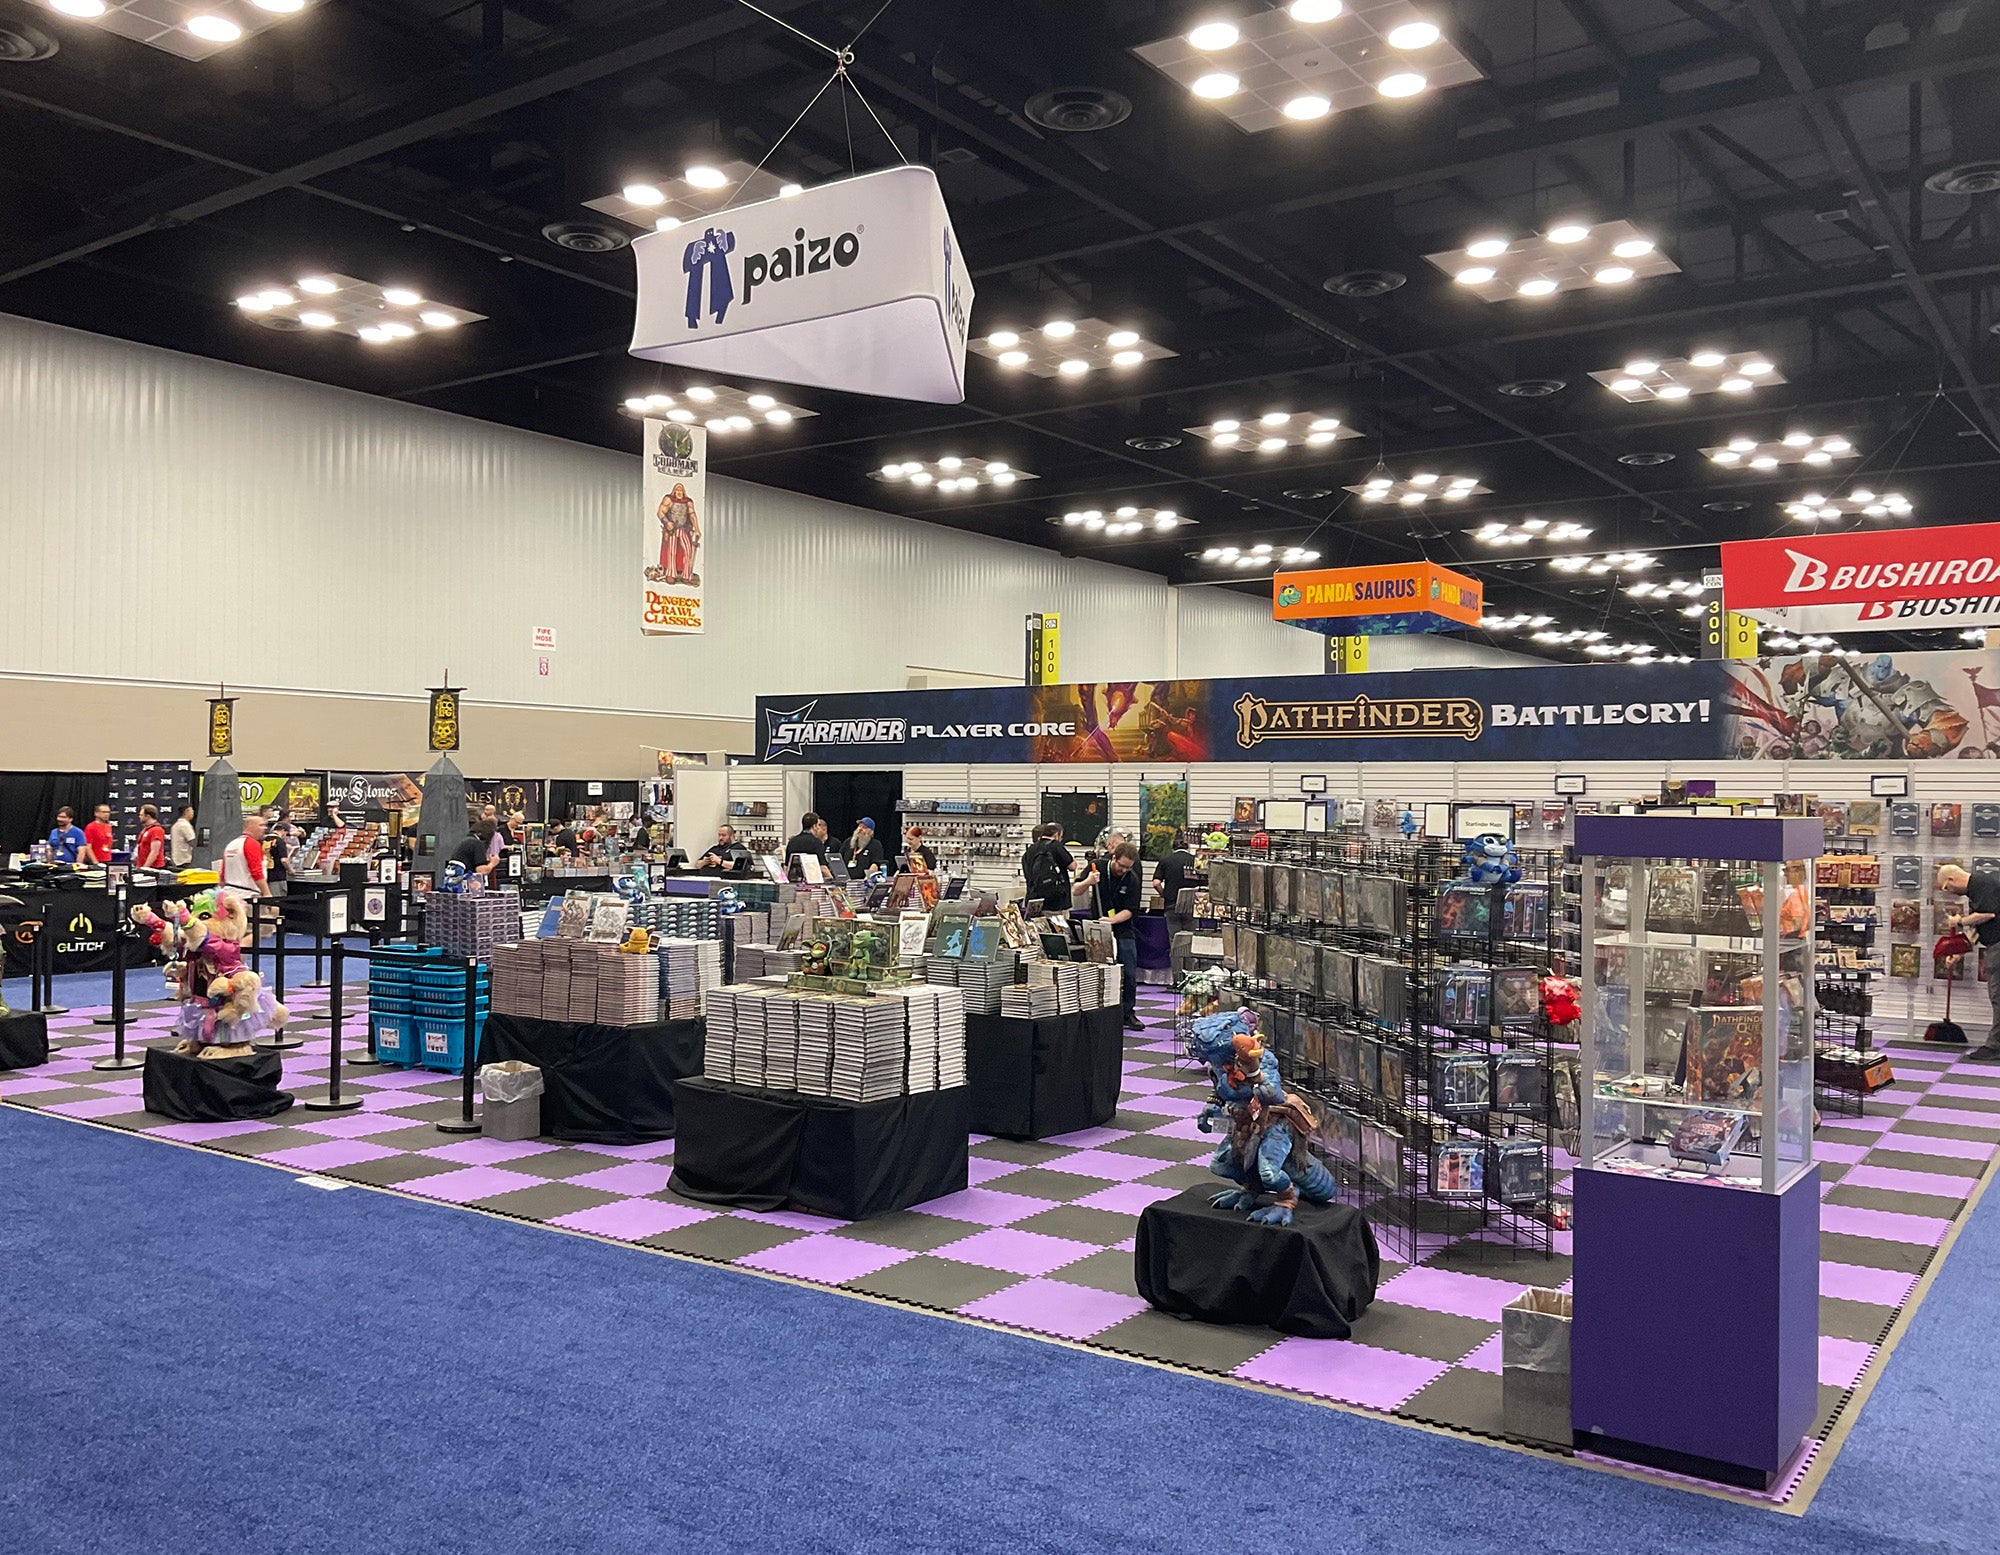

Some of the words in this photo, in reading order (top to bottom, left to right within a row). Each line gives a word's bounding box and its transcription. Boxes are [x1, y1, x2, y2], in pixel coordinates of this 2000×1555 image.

[741, 227, 860, 305] paizo
[645, 590, 701, 608] DUNGEON
[1306, 578, 1416, 604] PANDASAURUS
[644, 610, 702, 627] CLASSICS
[650, 602, 696, 618] CRAWL
[1708, 600, 1720, 645] 300
[1239, 696, 1476, 743] PATHFINDER
[1491, 699, 1711, 727] BATTLECRY!
[771, 720, 905, 745] STARFINDER
[911, 723, 1004, 739] PLAYER
[1008, 722, 1076, 737] CORE
[56, 941, 105, 953] GLITCH
[1712, 1014, 1763, 1027] PATHFIND
